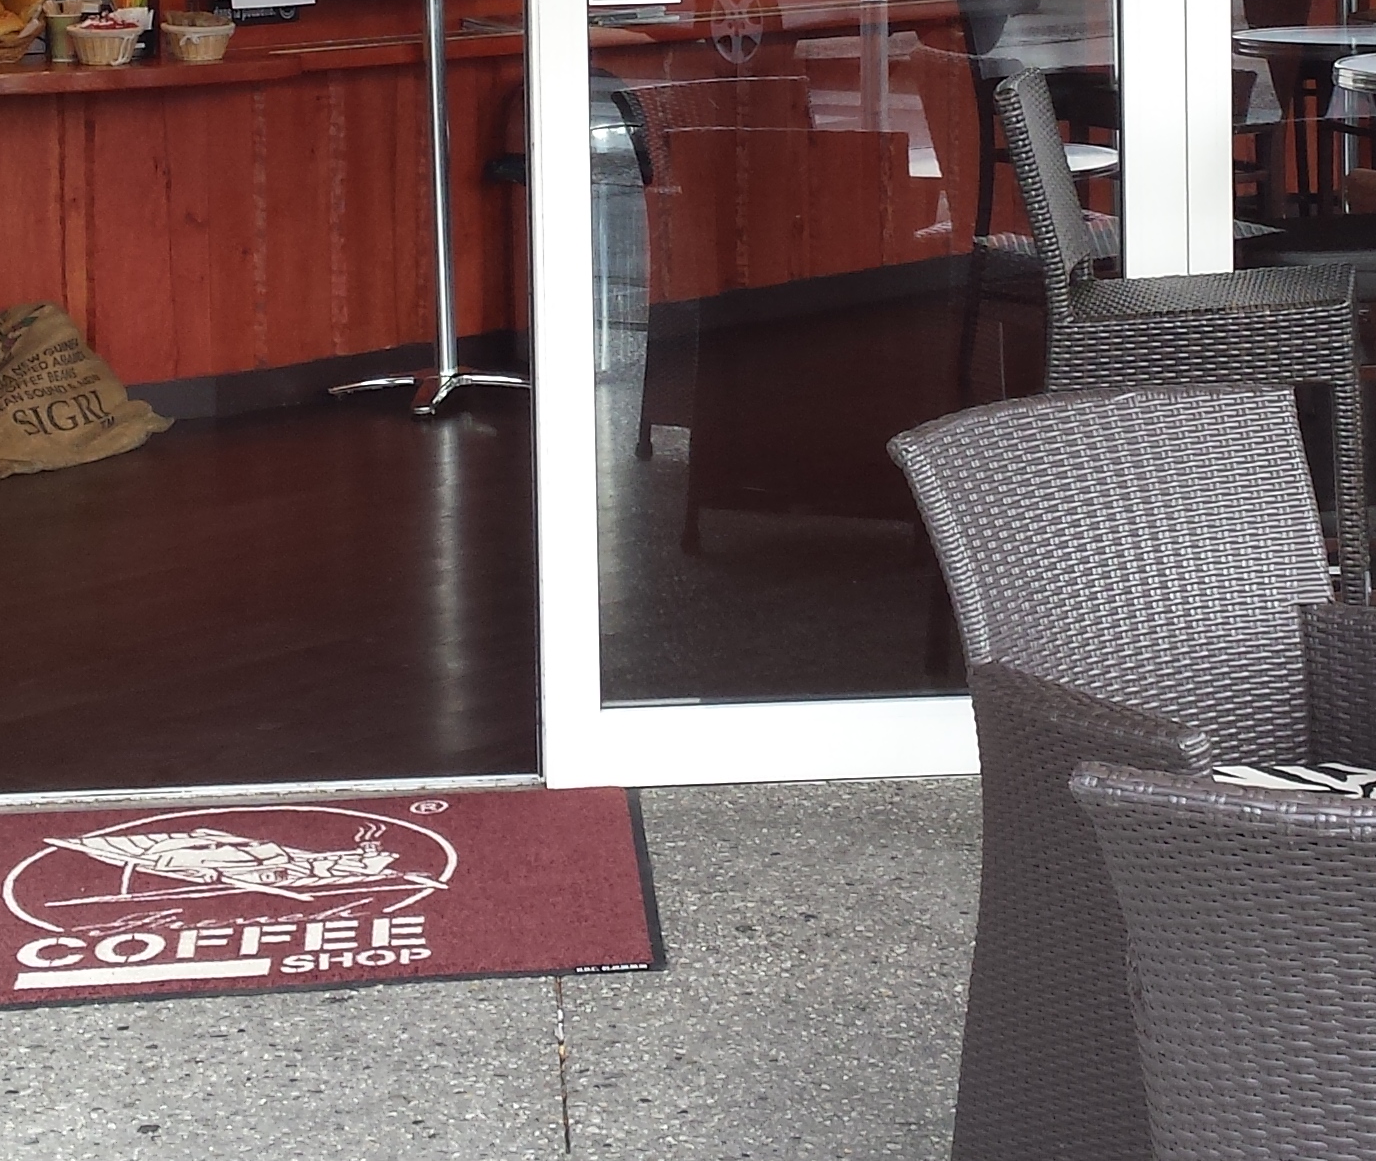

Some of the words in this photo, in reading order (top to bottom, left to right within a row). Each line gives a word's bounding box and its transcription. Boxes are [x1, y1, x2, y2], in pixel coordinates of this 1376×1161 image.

[24, 385, 68, 401] SOUND
[12, 389, 112, 436] SIGRI
[15, 915, 426, 969] COFFEE
[280, 948, 432, 975] SHOP
